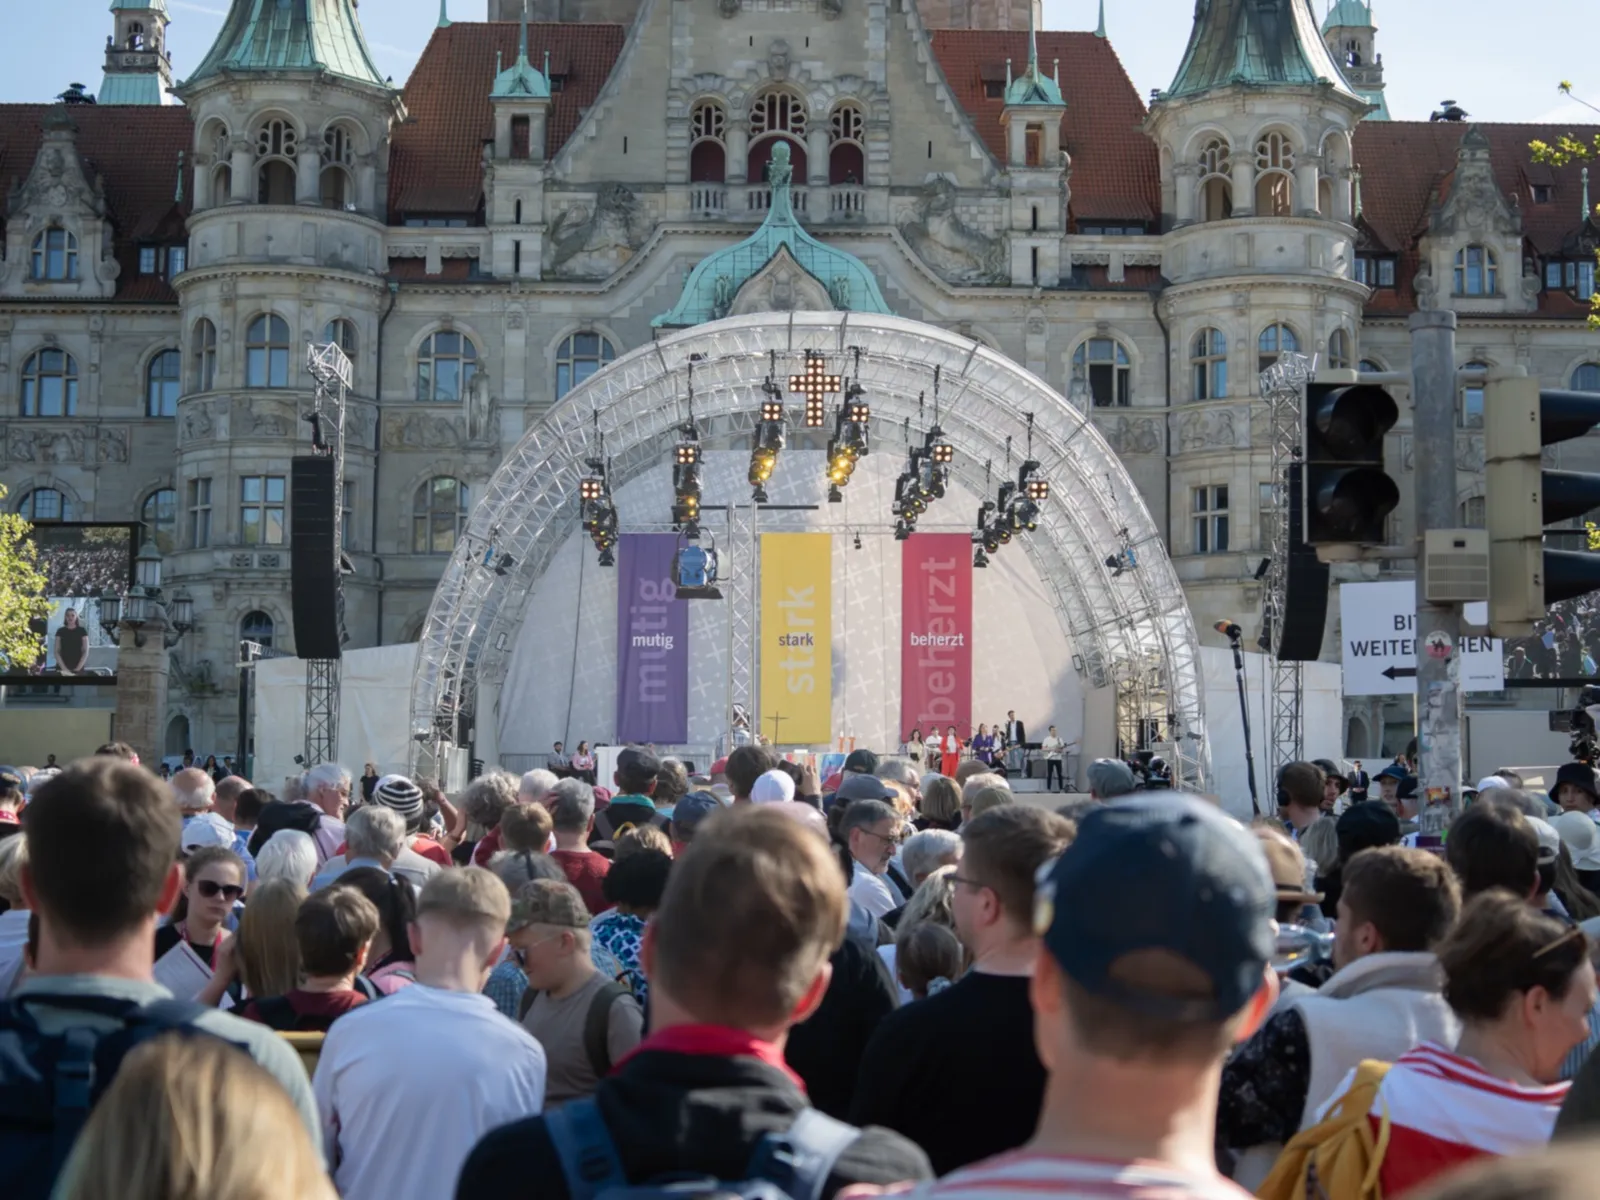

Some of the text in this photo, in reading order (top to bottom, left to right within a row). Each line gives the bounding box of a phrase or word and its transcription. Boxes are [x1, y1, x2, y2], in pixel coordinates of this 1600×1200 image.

[630, 578, 677, 702] mutig
[632, 632, 674, 650] mutig
[777, 584, 815, 695] stark
[778, 632, 814, 647] stark
[910, 632, 964, 646] beherzt
[918, 557, 956, 722] beherzt
